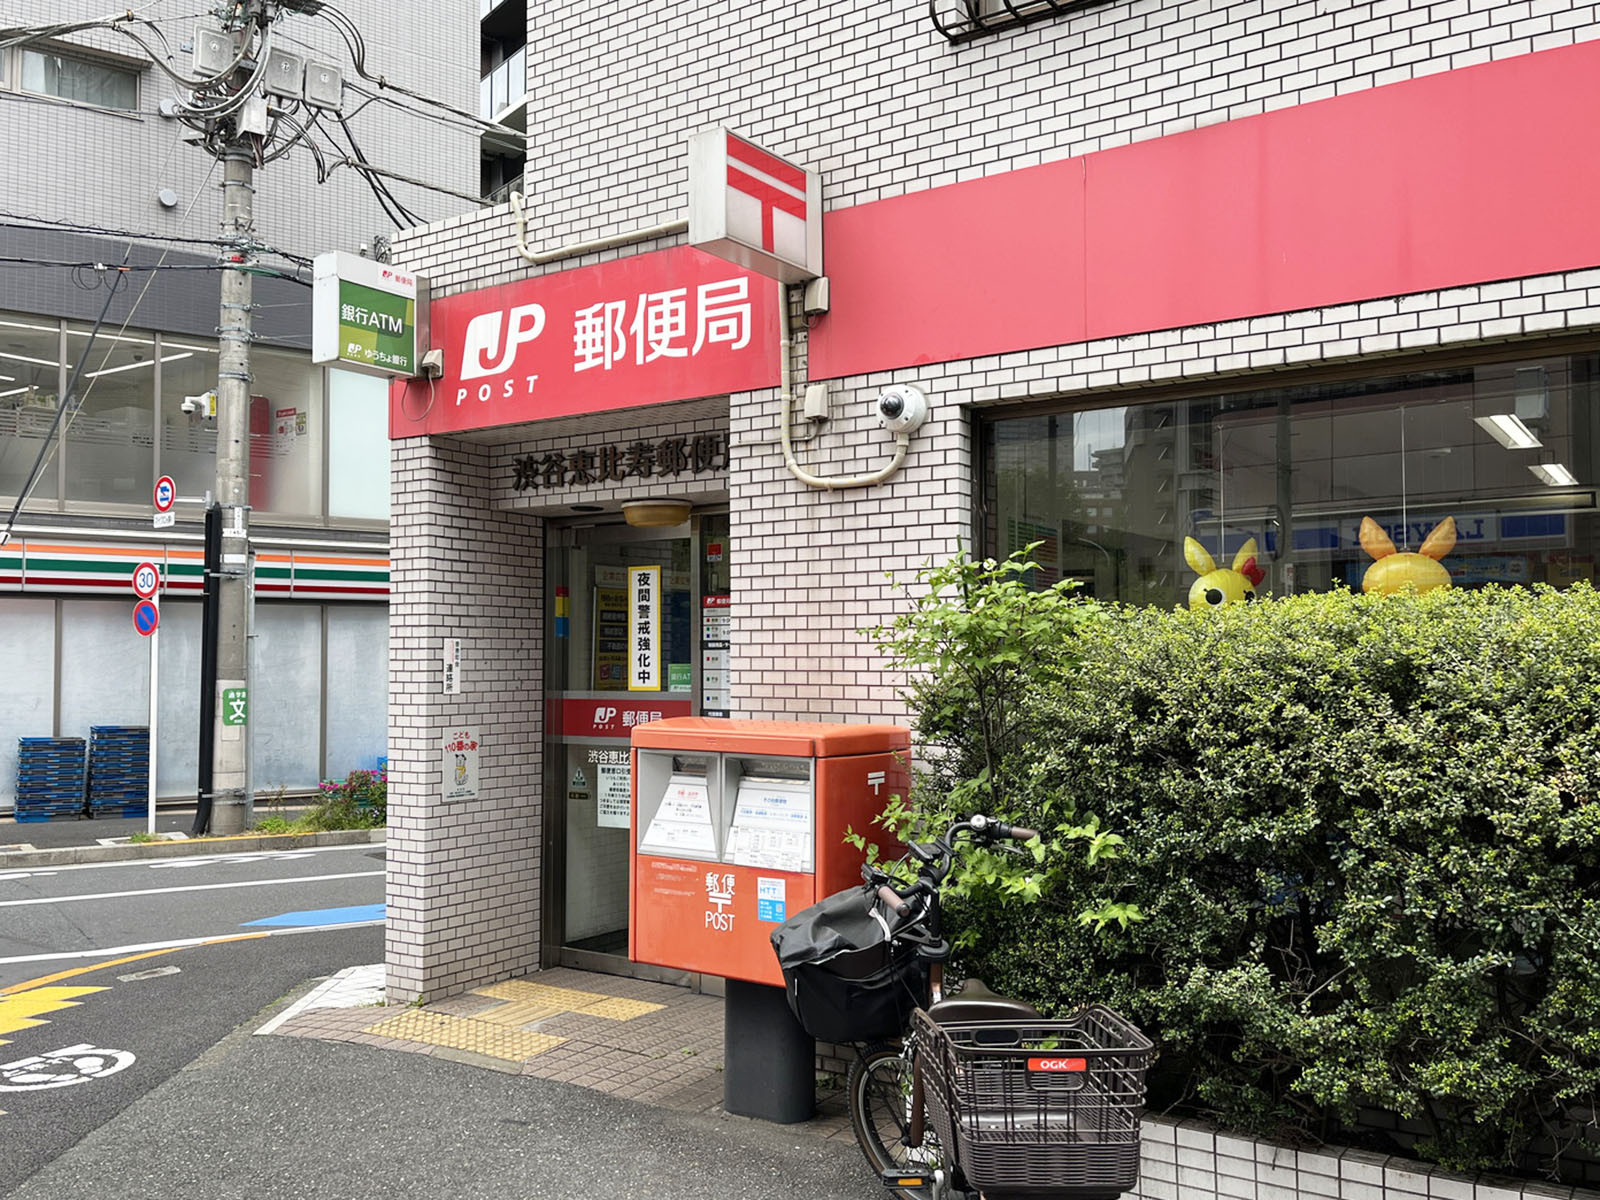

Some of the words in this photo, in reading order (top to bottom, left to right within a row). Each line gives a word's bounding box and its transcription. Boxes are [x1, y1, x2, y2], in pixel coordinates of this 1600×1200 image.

[341, 303, 403, 334] 銀行ATM
[573, 276, 752, 373] 郵便局
[364, 348, 408, 367] ゆうちょ銀行
[456, 374, 538, 406] POST
[138, 572, 154, 589] 30
[637, 572, 651, 684] 夜間警戒強化中
[453, 730, 471, 741] こども
[445, 740, 478, 753] 110番の家
[588, 749, 631, 765] 渋谷恵比
[705, 872, 736, 896] 郵便
[705, 911, 736, 932] POST
[1040, 1060, 1068, 1070] OGK
